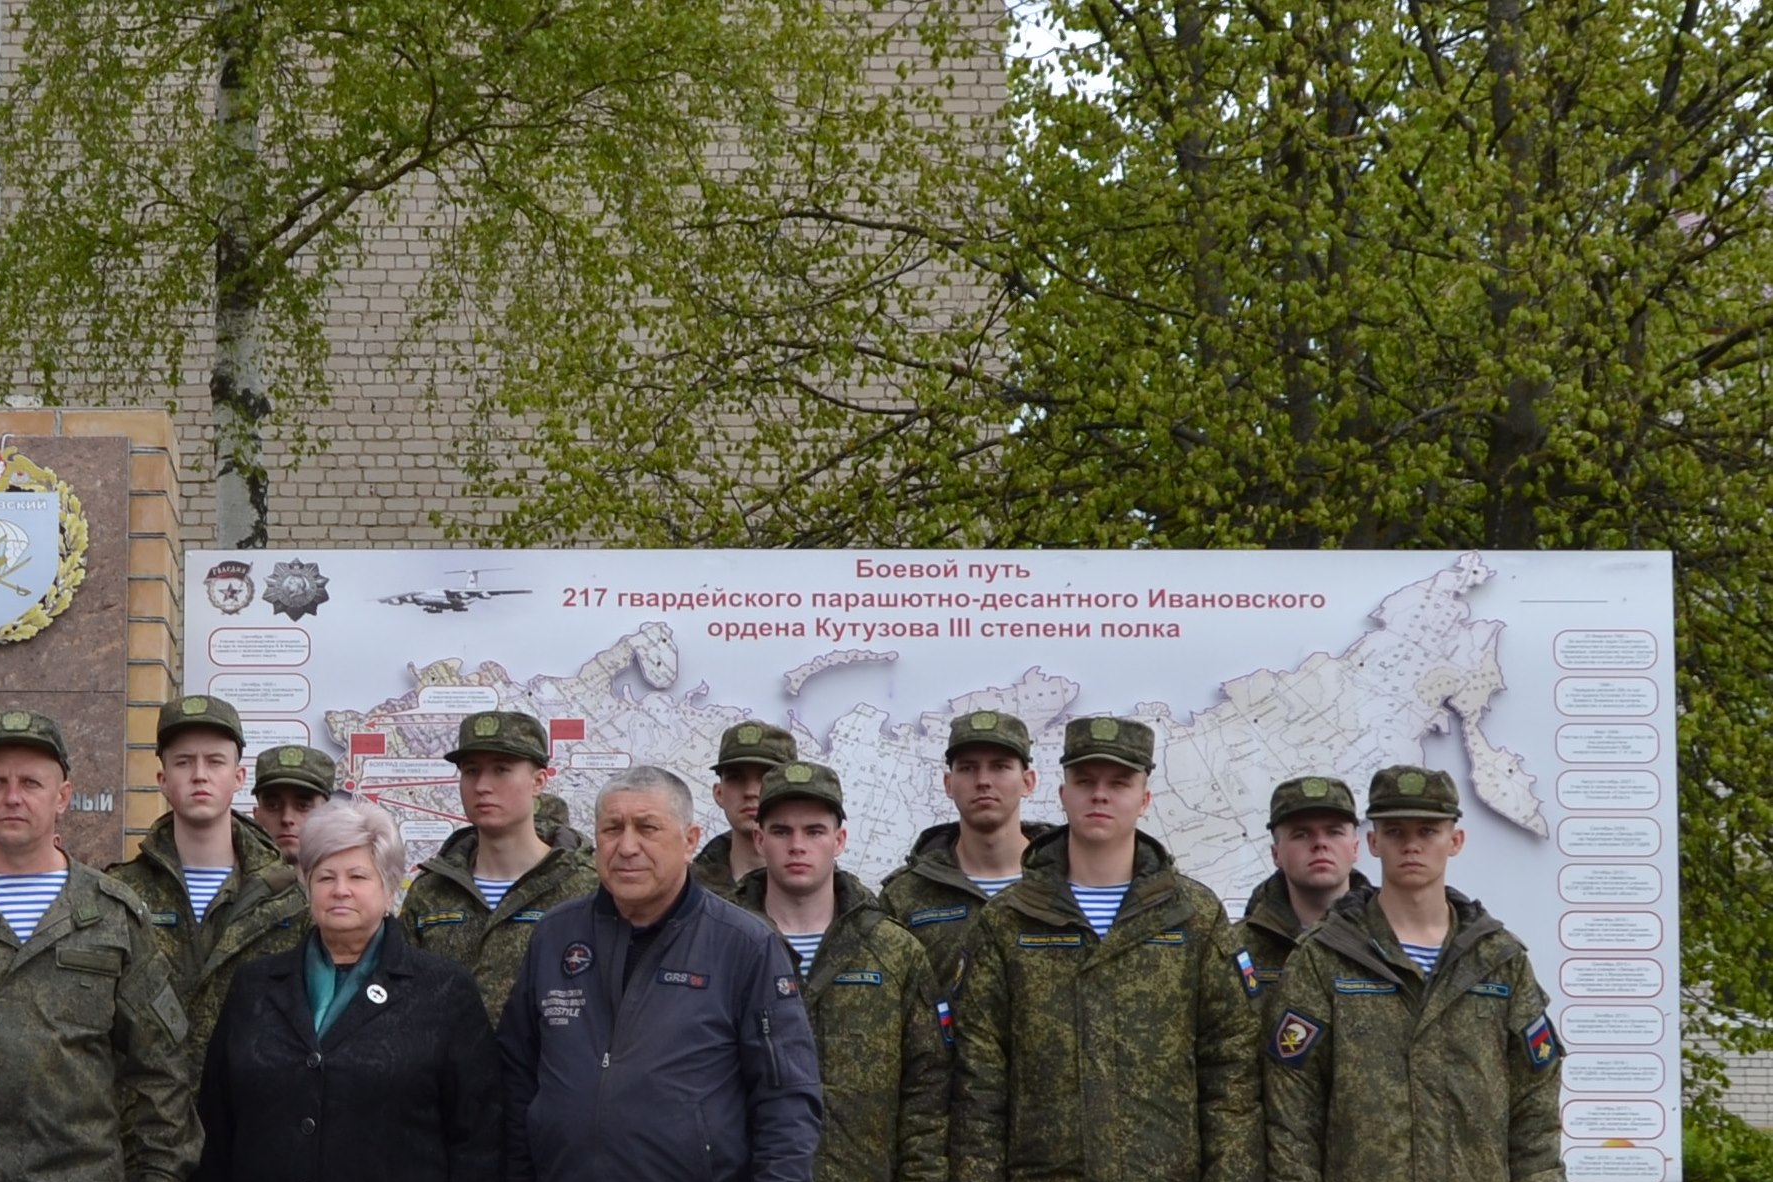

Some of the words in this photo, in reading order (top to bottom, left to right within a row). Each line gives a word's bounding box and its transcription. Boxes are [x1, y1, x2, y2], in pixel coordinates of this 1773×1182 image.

[855, 558, 958, 579] Боевой
[968, 562, 1031, 583] путь
[561, 587, 607, 608] 217
[617, 587, 803, 612] гвардейского
[811, 590, 1139, 612] парашютно-десантного
[1148, 588, 1326, 609] Ивановского
[707, 621, 805, 642] ордена
[816, 618, 939, 642] Кутузова
[949, 617, 971, 638] III
[980, 621, 1090, 638] степени
[1101, 621, 1181, 638] полка
